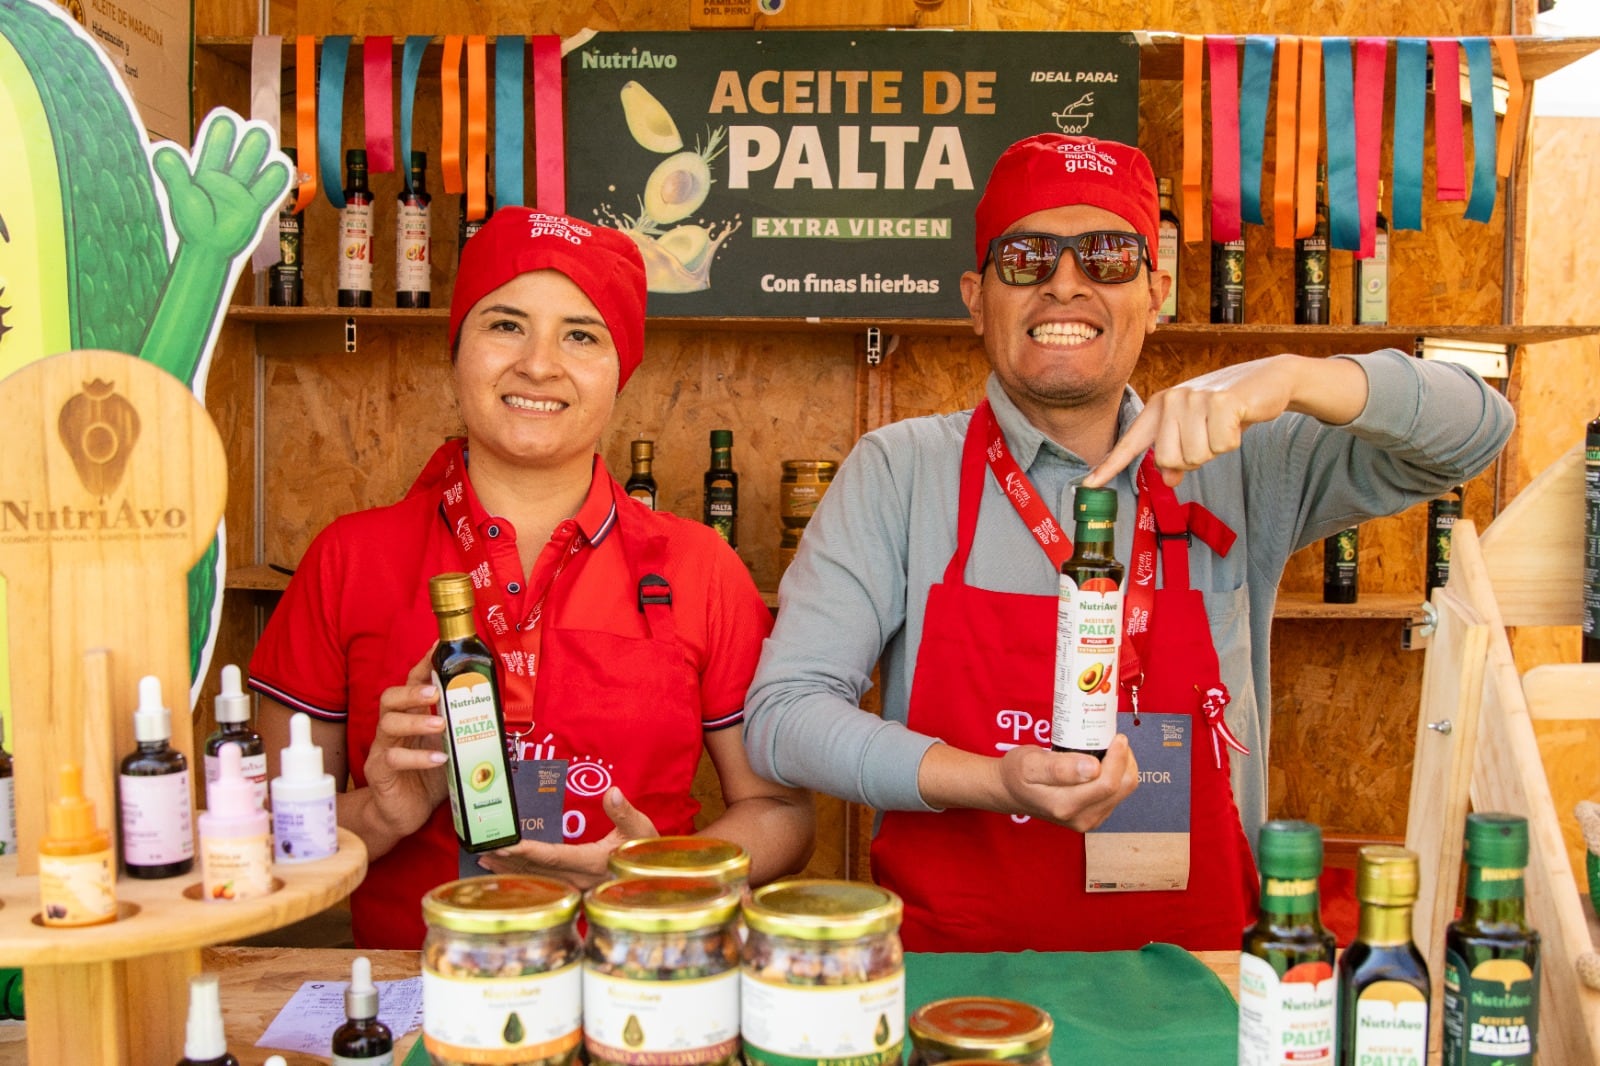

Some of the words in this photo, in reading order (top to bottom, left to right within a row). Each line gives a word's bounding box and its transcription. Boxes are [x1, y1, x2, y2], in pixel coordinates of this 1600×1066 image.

[582, 47, 677, 69] NutriAvo
[1030, 71, 1072, 83] IDEAL
[1075, 71, 1119, 83] PARA:
[708, 70, 903, 115] ACEITE
[922, 70, 997, 115] DE
[727, 125, 975, 191] PALTA
[1065, 159, 1114, 176] gusto
[530, 227, 582, 246] gusto
[755, 218, 840, 237] EXTRA
[849, 218, 947, 237] VIRGEN
[760, 273, 800, 294] Con
[803, 273, 857, 294] finas
[860, 273, 940, 294] hierbas
[0, 497, 187, 532] NutriAvo
[1079, 624, 1117, 636] PALTA
[450, 695, 491, 709] NutriAvo
[455, 719, 496, 737] PALTA
[996, 709, 1051, 743] Pe
[1281, 1027, 1332, 1047] PALTA
[1471, 1023, 1531, 1044] PALTA
